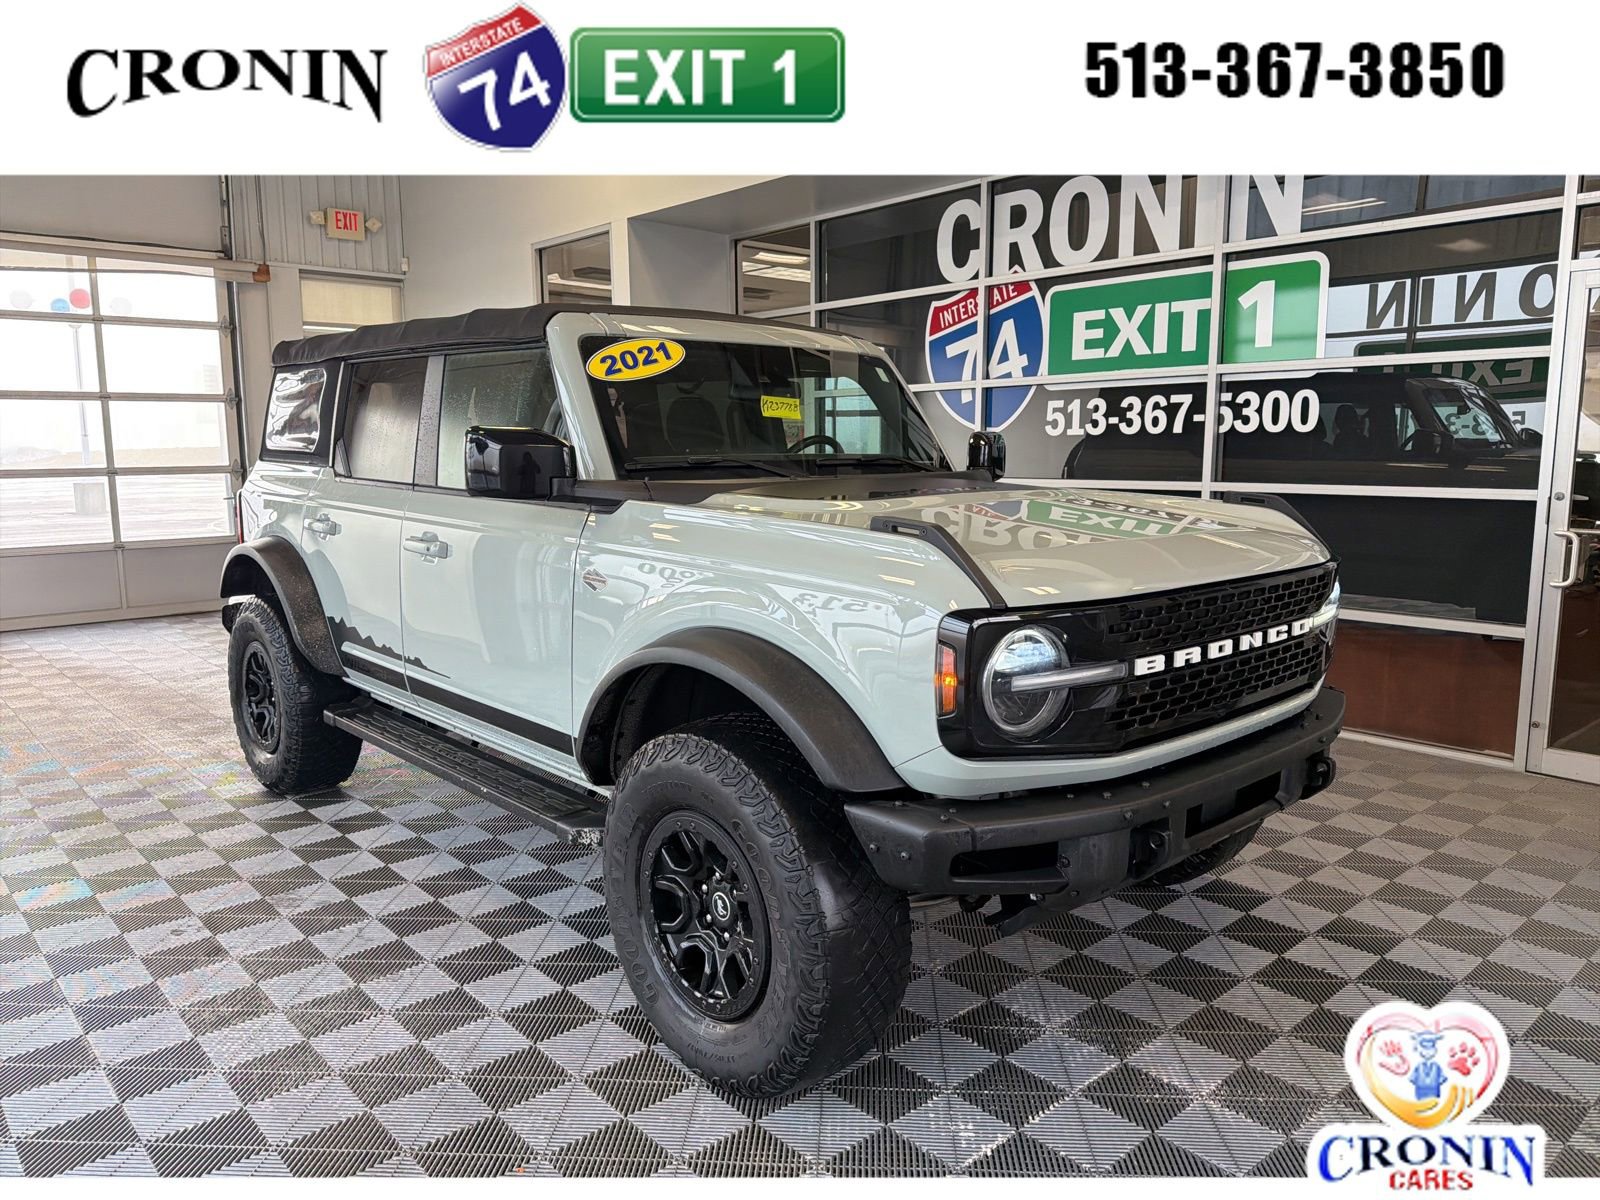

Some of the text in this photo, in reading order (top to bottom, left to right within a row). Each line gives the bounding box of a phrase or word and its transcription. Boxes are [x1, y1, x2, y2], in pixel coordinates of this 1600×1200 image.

[335, 211, 359, 232] EXIT
[1072, 280, 1276, 361] EXIT 1
[600, 341, 673, 377] 2021
[945, 318, 1029, 405] 74
[1045, 388, 1321, 437] 513-367-5300
[1134, 617, 1312, 676] BRONCO
